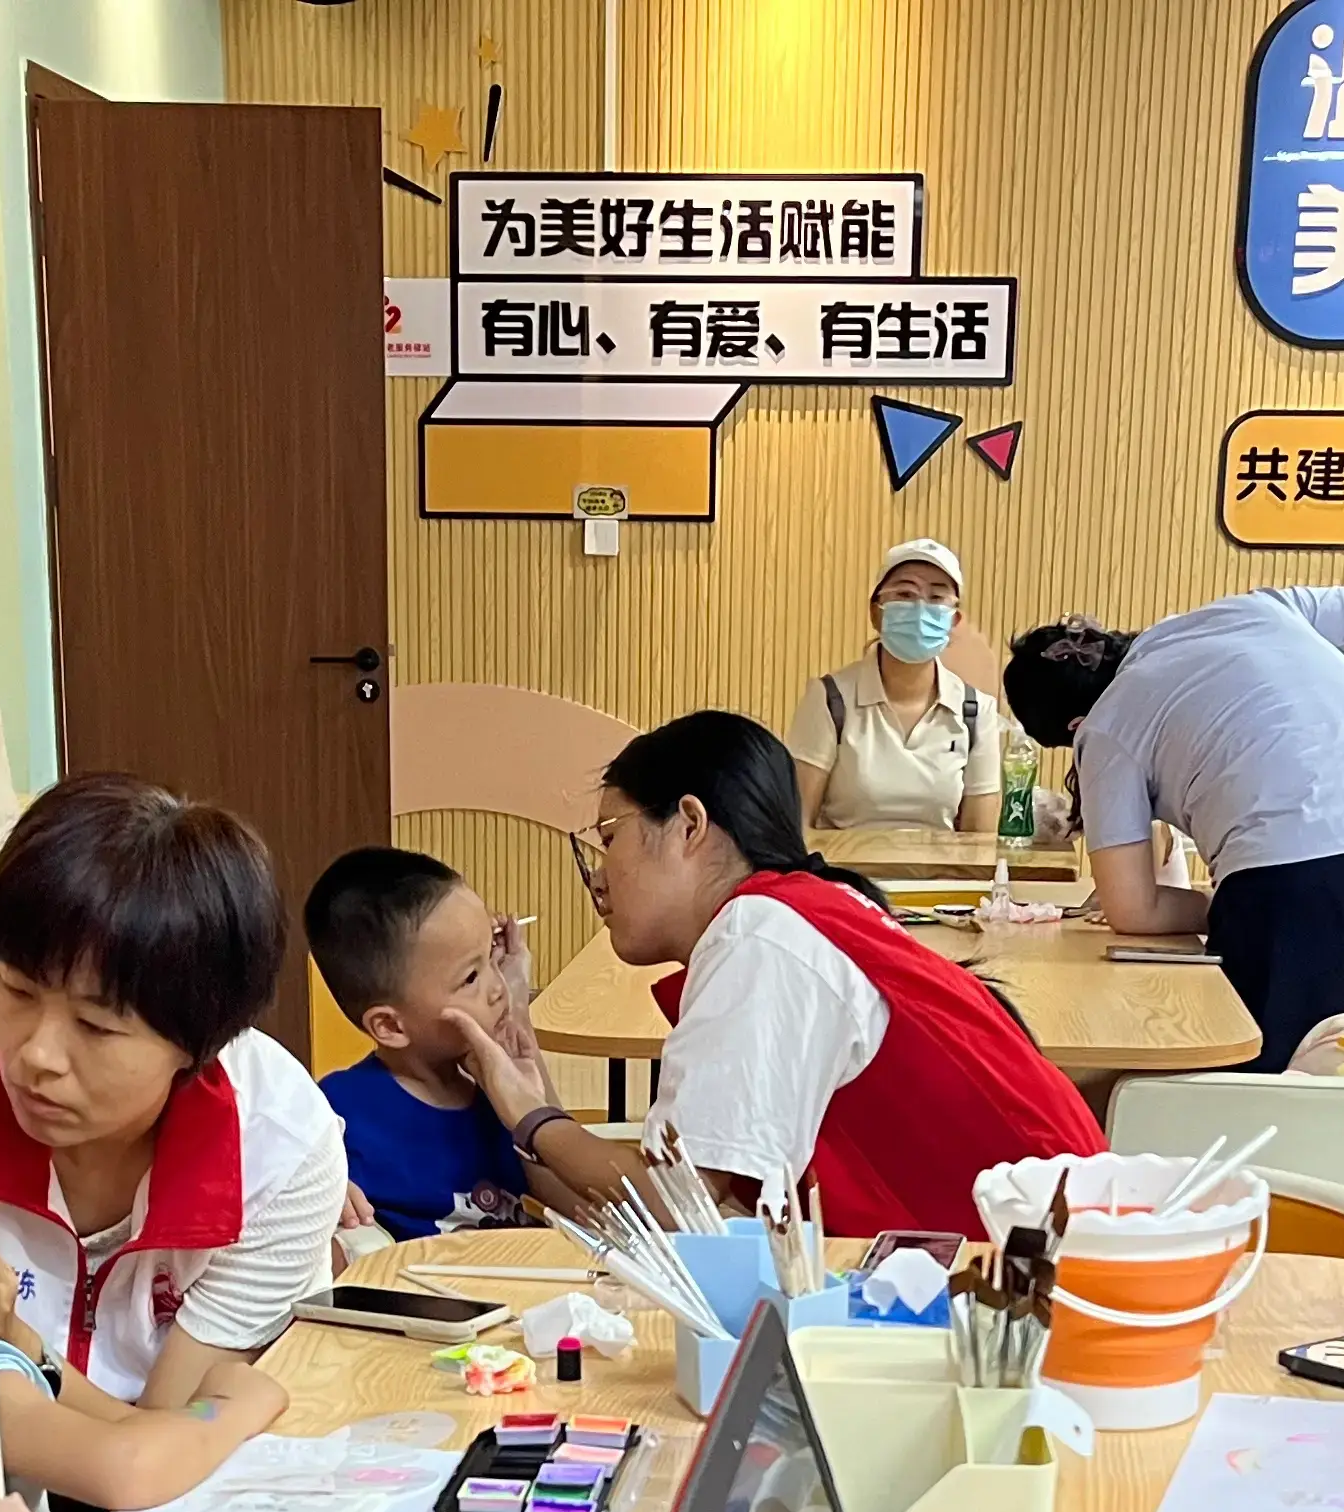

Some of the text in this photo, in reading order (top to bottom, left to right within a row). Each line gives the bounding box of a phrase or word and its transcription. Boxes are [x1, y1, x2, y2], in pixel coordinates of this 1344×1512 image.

[481, 198, 895, 259] 为美好生活赋能
[481, 300, 989, 361] 有心、有爱、有生活
